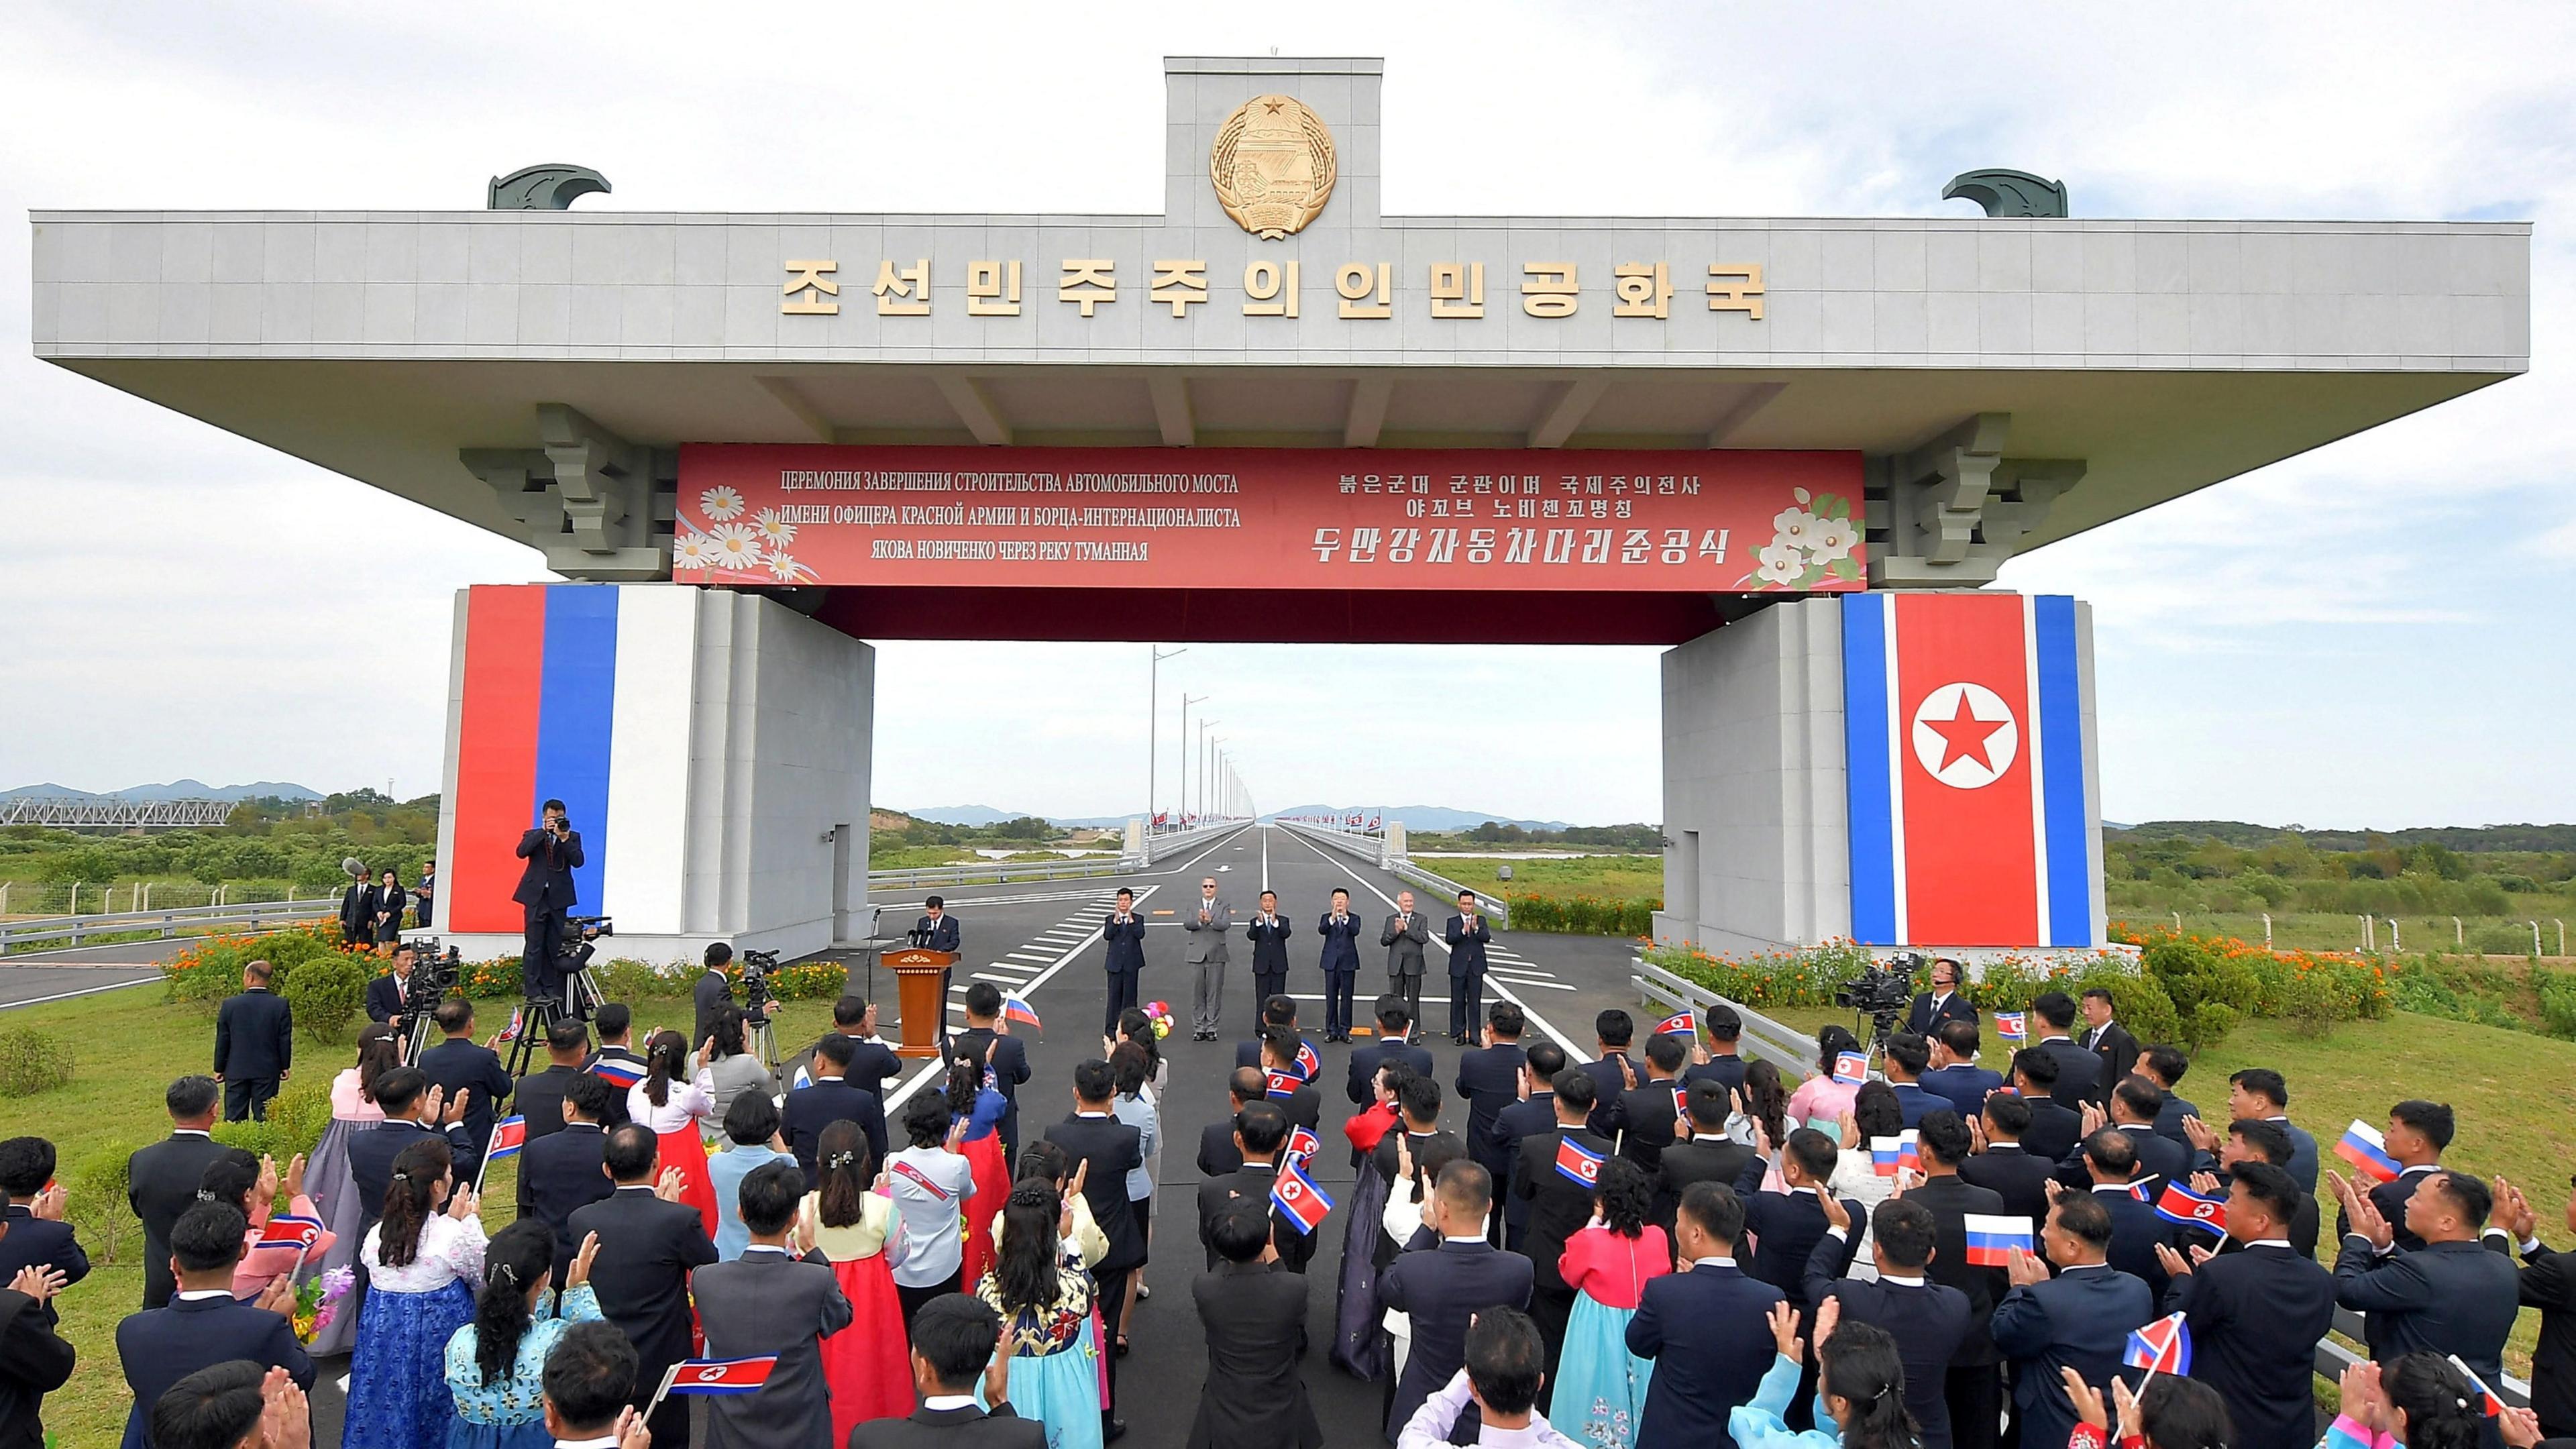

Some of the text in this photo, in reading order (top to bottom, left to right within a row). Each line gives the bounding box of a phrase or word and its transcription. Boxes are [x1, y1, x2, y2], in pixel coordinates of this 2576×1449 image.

[782, 260, 1765, 320] 조선민주주의인민공화국
[781, 471, 1238, 493] ЦЕРЕМОНИЯ ЗАВЕРШЕНИЯ СТРОИТЕЛЬСТВА АВТОМОБИЛЬНОГО МОСТА
[1338, 475, 1701, 495] 붉은군대 군관이며 국제주의전사
[780, 501, 1241, 531] ИМЕНИ ОФИЦЕРА КРАСНОЙ АРМИИ И БОРЦА-ИНТЕРНАЦИОНАЛИСТА
[1406, 498, 1631, 519] 야꼬브 노비첸꼬명칭
[870, 539, 1148, 561] ЯКОВА НОВИЧЕНКО ЧЕРЕЗ РЕКУ ТУМАННАЯ
[1311, 527, 1730, 564] 두만강자동차다리준공식
